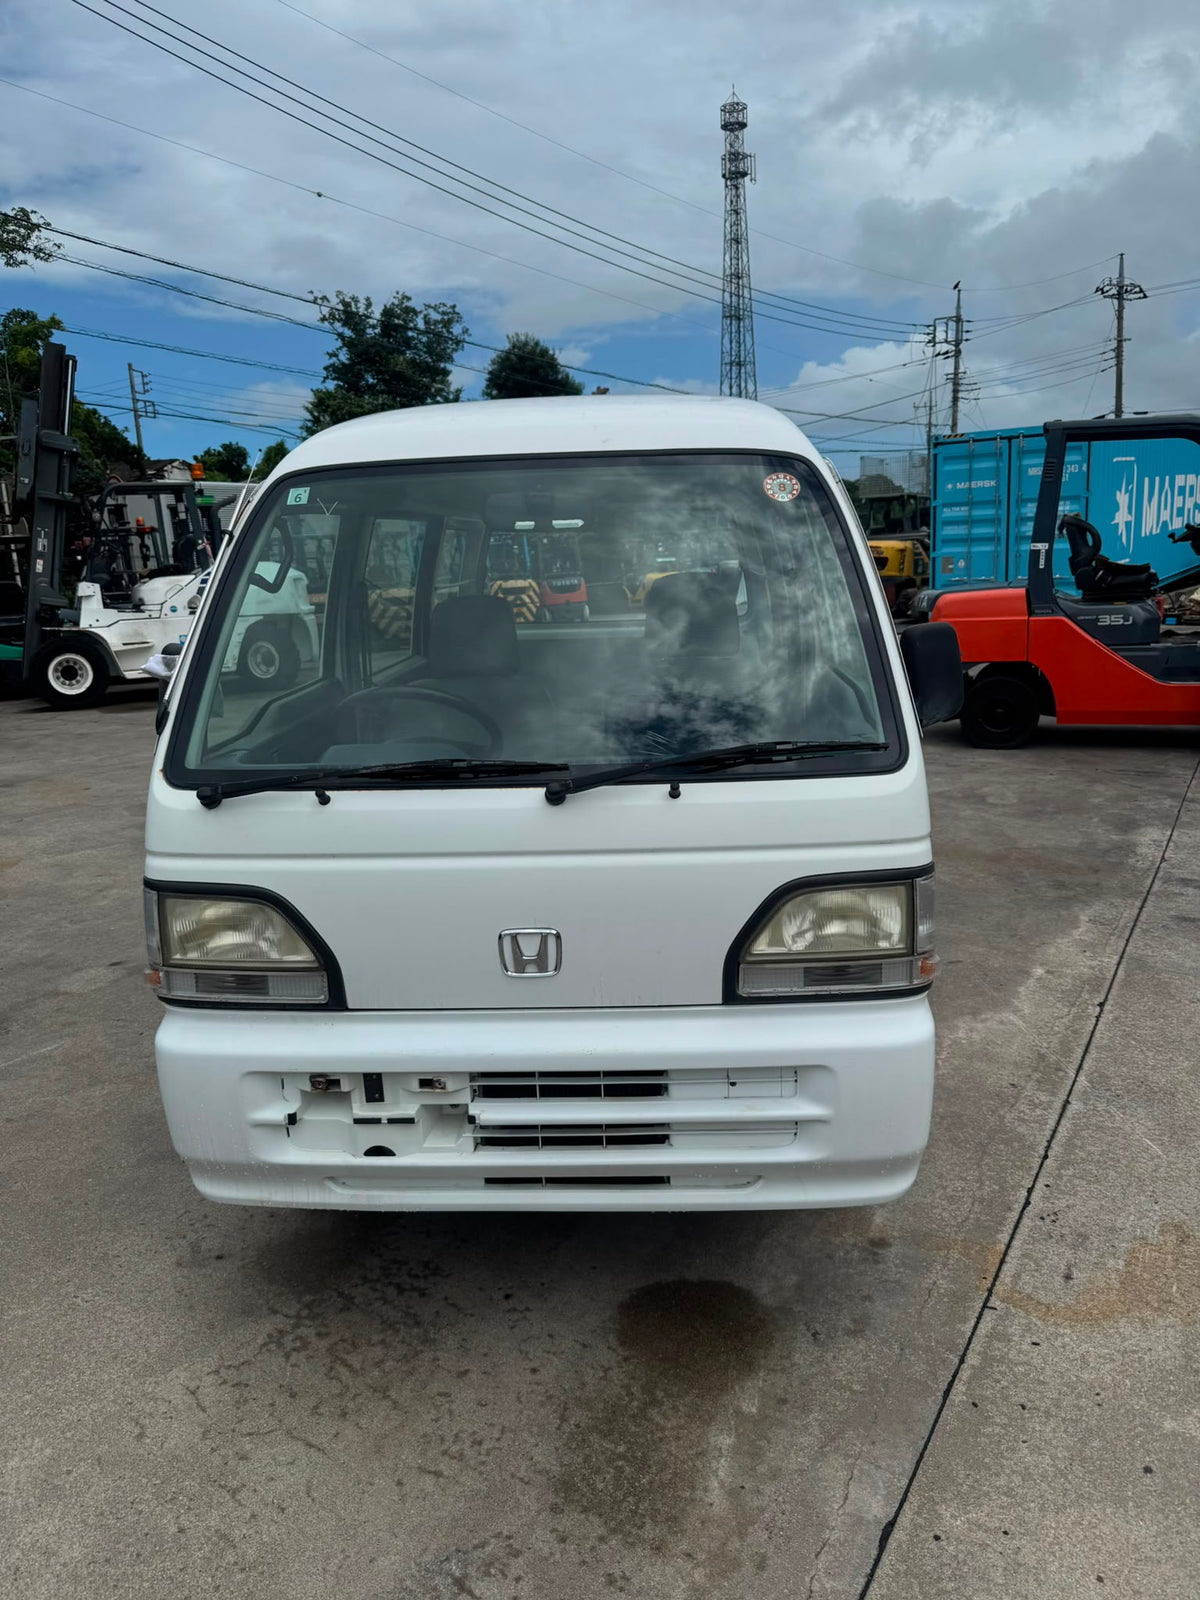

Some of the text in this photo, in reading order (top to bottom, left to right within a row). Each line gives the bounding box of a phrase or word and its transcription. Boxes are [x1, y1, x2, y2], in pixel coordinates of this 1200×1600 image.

[956, 479, 997, 489] MAERSK
[294, 493, 302, 503] 6
[1097, 614, 1134, 625] 35J
